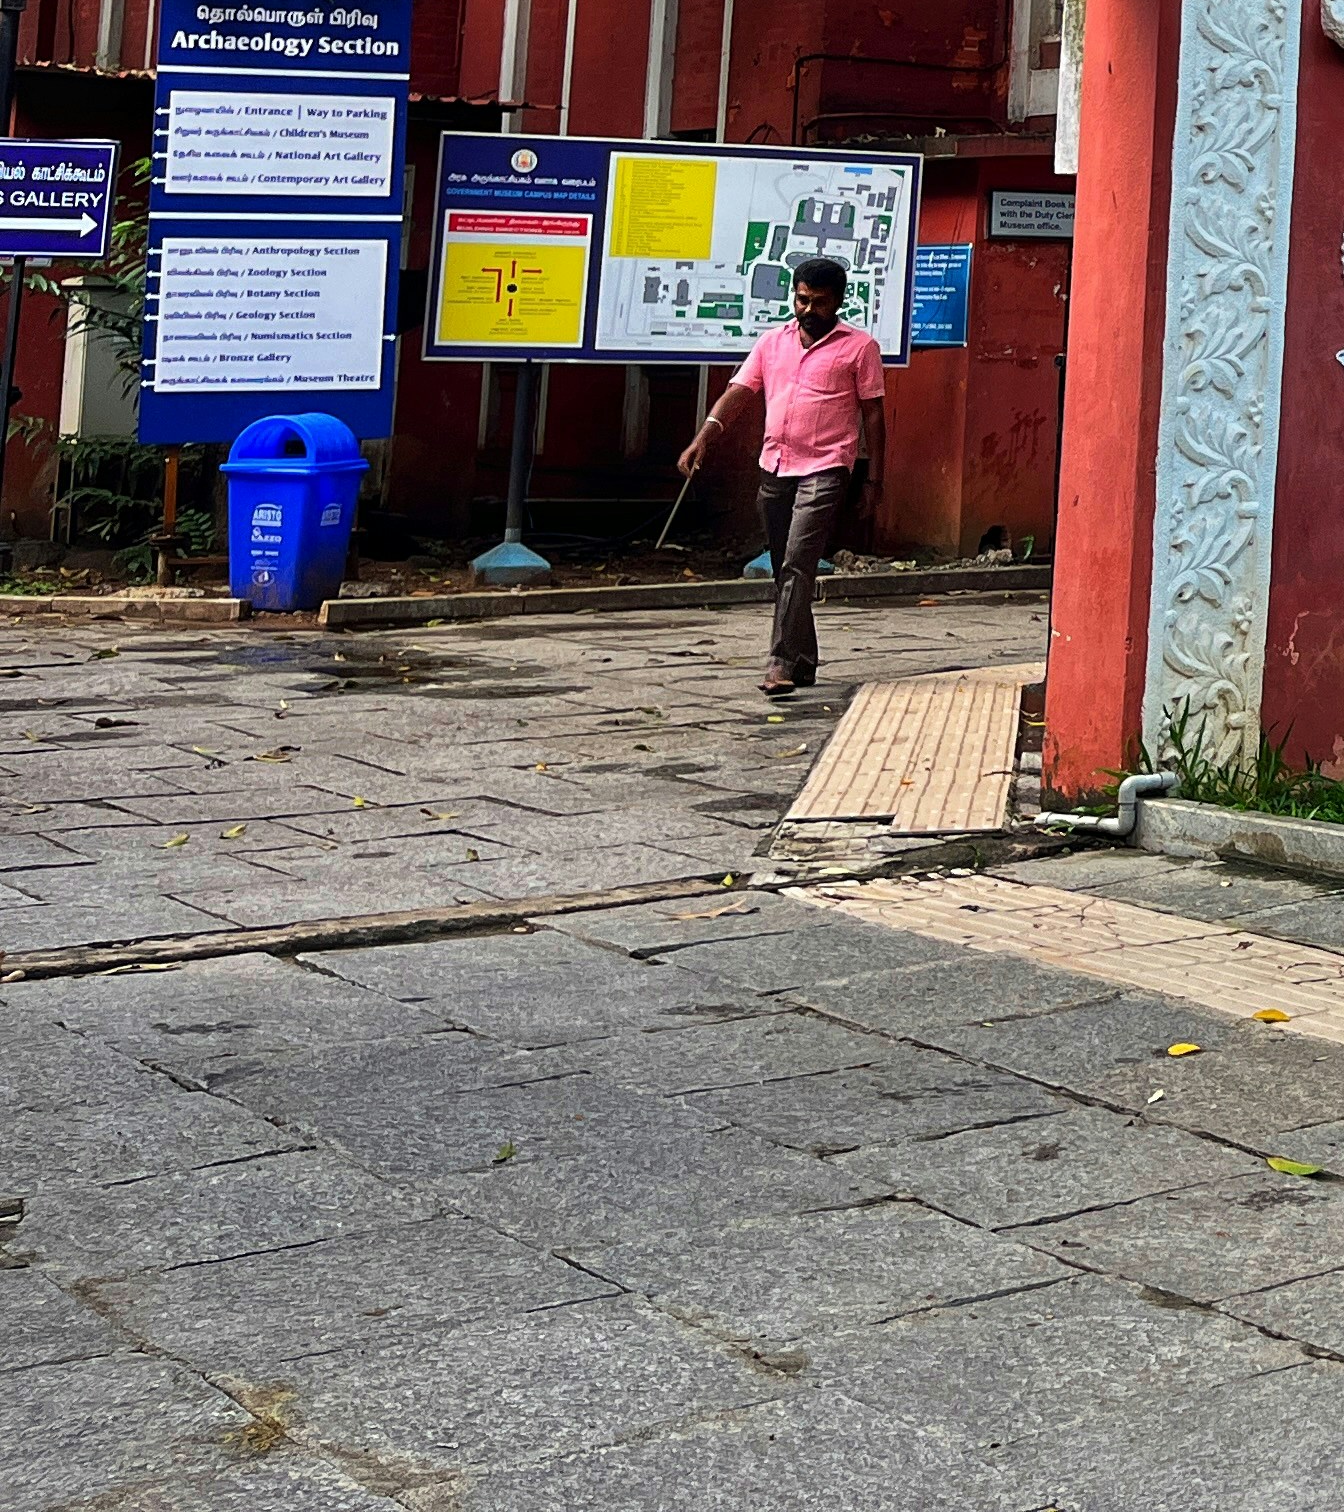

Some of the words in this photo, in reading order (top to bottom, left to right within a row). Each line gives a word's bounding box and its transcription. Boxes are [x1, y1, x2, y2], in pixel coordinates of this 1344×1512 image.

[196, 4, 324, 26] தொல்பொருள்
[329, 8, 378, 29] பிரிவு
[171, 30, 314, 56] Archaeology
[318, 37, 399, 56] Section
[244, 106, 293, 116] Entrance
[307, 108, 329, 119] Way
[331, 109, 343, 118] to
[346, 109, 387, 120] Parking
[279, 128, 327, 138] Children's
[329, 130, 369, 139] Museum
[275, 150, 321, 160] National
[323, 152, 341, 161] Art
[343, 152, 382, 164] Gallery
[257, 174, 330, 185] Contemporary
[332, 175, 348, 184] Art
[350, 175, 386, 187] Gallery
[9, 190, 104, 208] GALLERY
[446, 188, 494, 197] GOVERNMENT
[494, 189, 523, 198] MUSEUM
[524, 190, 552, 199] CAMPUS
[553, 191, 568, 200] MAP
[568, 192, 596, 201] DETAILS
[1000, 198, 1043, 209] Complaint
[1045, 199, 1066, 208] Book
[1000, 210, 1018, 218] with
[1019, 210, 1033, 218] the
[1035, 210, 1054, 220] Duty
[1000, 221, 1035, 230] Museum
[252, 246, 321, 257] Anthropology
[323, 246, 360, 256] Section
[247, 268, 288, 278] Zoology
[290, 268, 327, 277] Section
[246, 289, 281, 300] Botany
[283, 289, 321, 298] Section
[235, 310, 277, 321] Geology
[278, 310, 316, 319] Section
[250, 331, 314, 341] Numismatics
[315, 331, 352, 340] Section
[219, 353, 254, 362] Bronze
[256, 352, 292, 364] Gallery
[293, 374, 333, 383] Museum
[338, 373, 376, 382] Theatre
